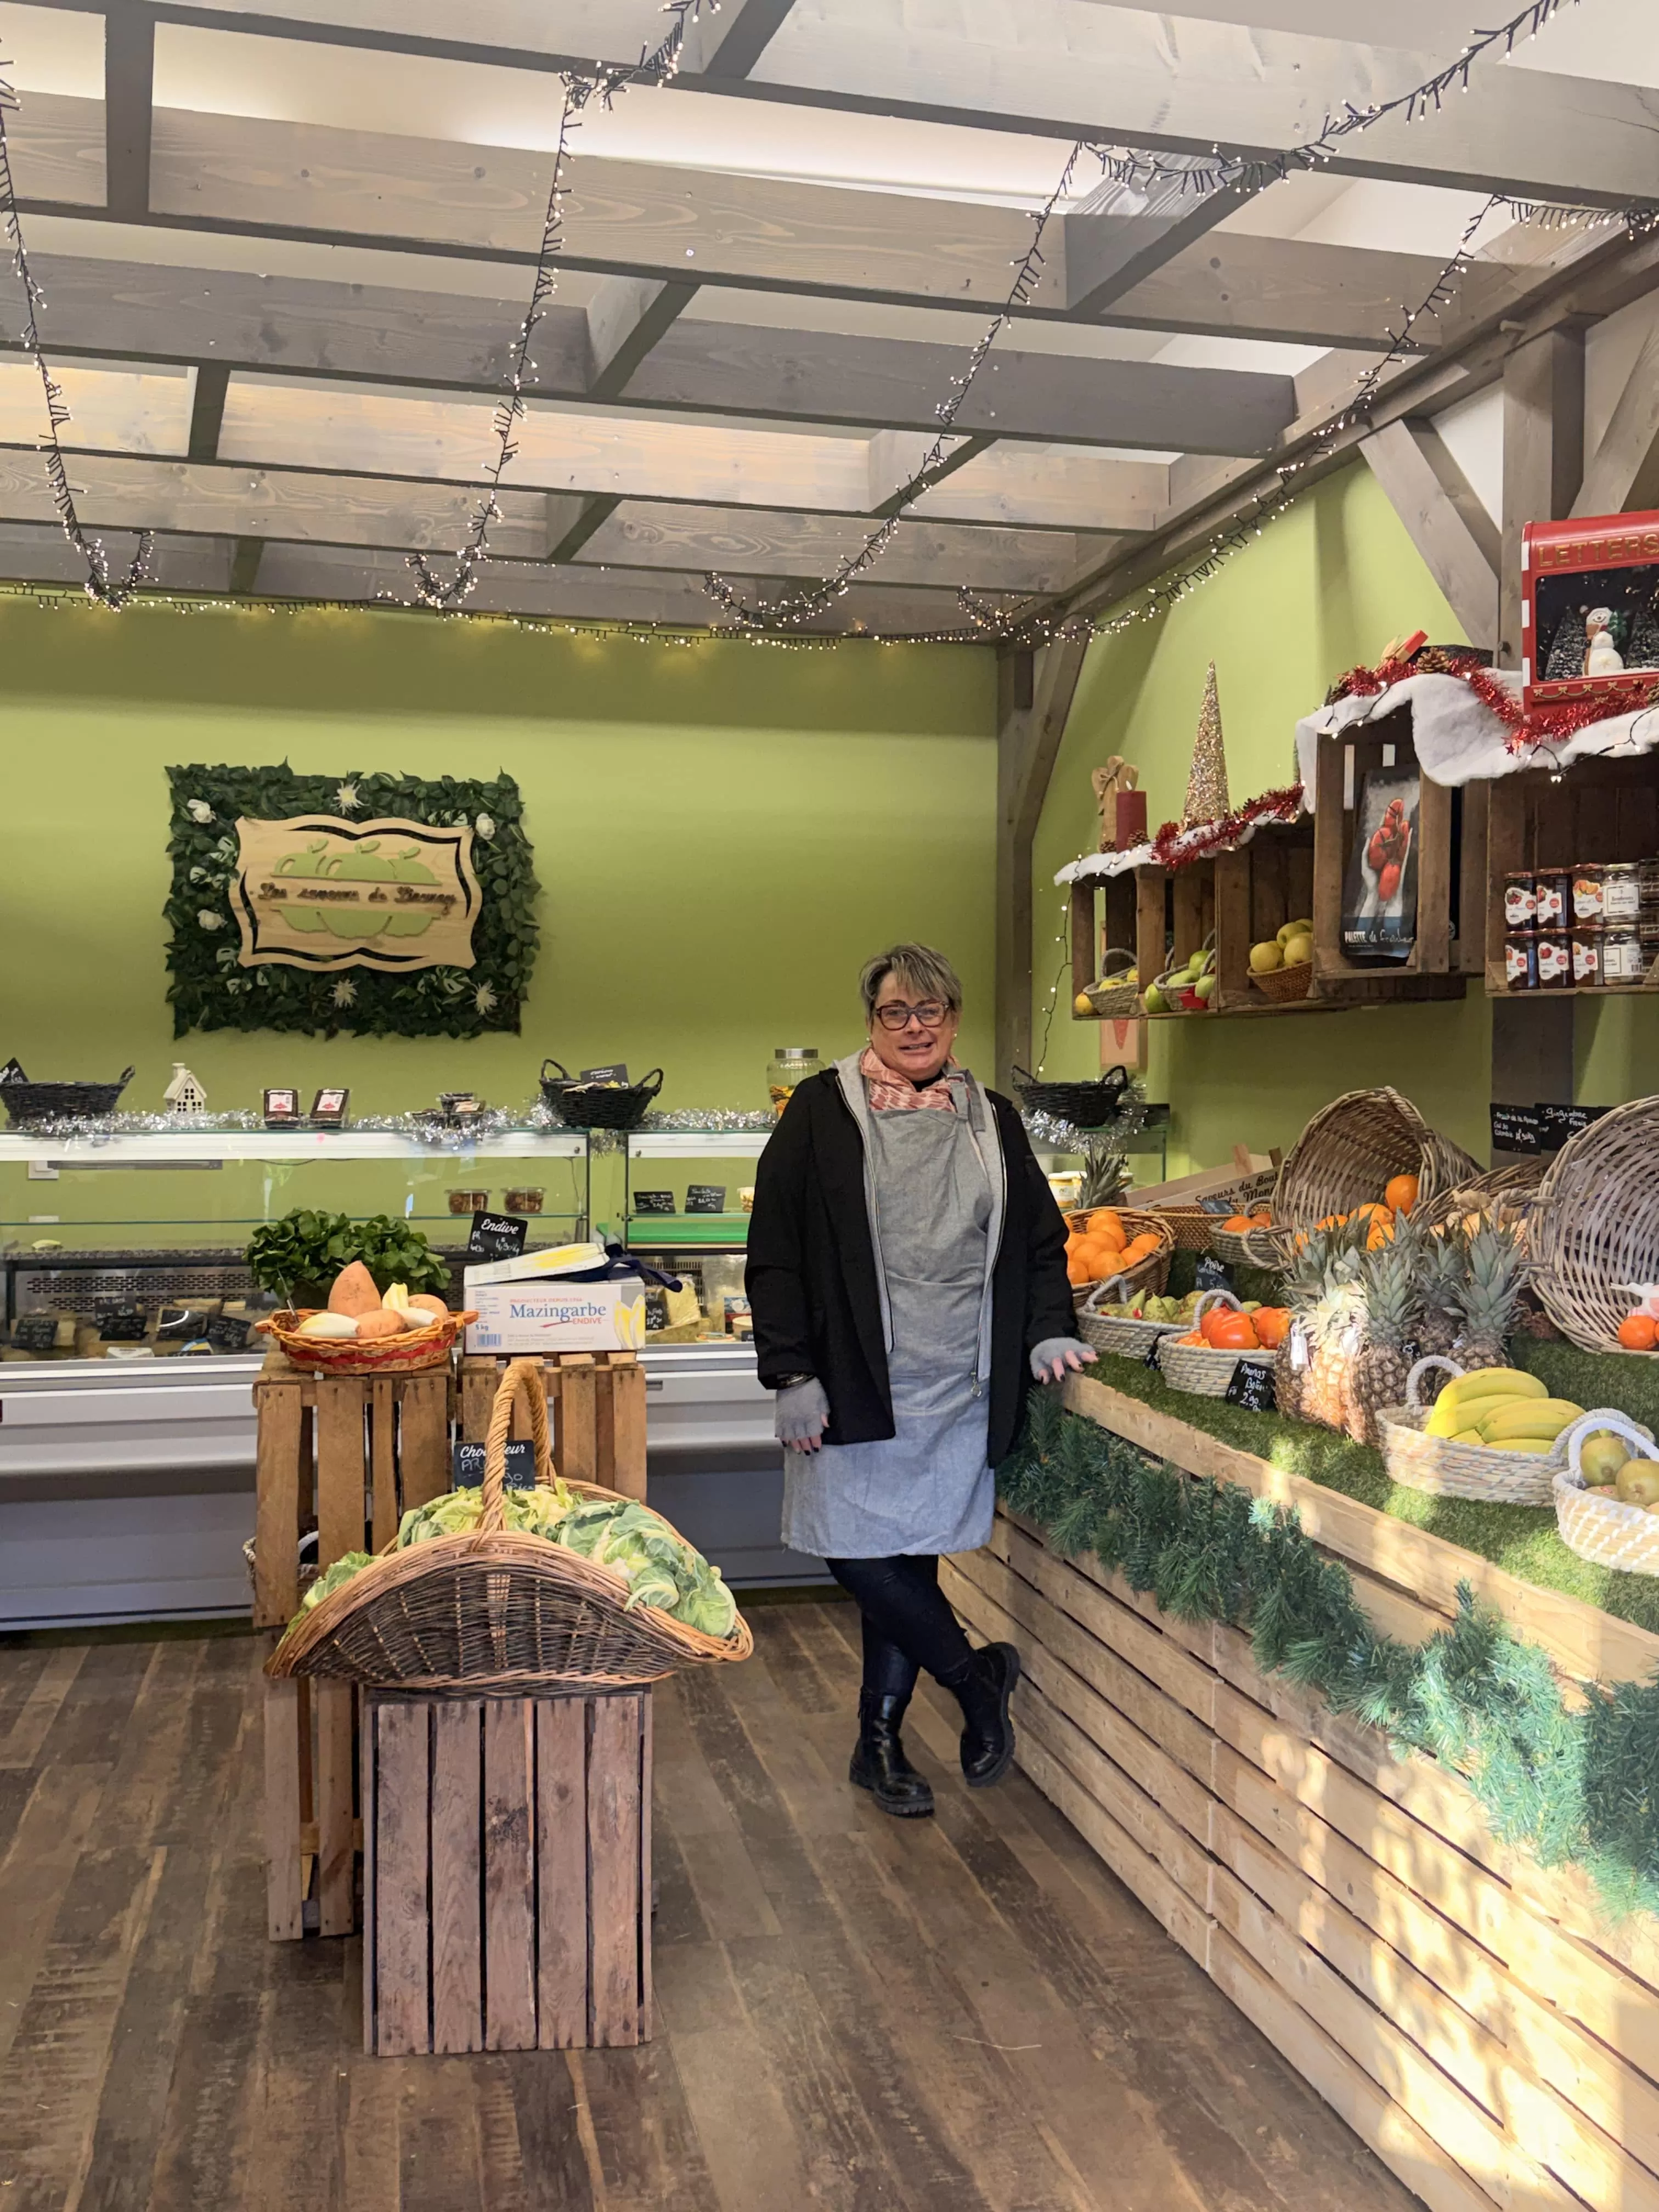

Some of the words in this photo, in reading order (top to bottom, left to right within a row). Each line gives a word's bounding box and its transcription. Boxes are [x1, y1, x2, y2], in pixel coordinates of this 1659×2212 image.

[1538, 534, 1659, 567] LETTERS
[368, 887, 387, 902] de
[1239, 1181, 1253, 1192] du
[1243, 1183, 1277, 1202] Mond
[481, 1218, 520, 1234] Endive
[1204, 1256, 1224, 1273] Poire
[510, 1302, 606, 1323] Mazingarbe
